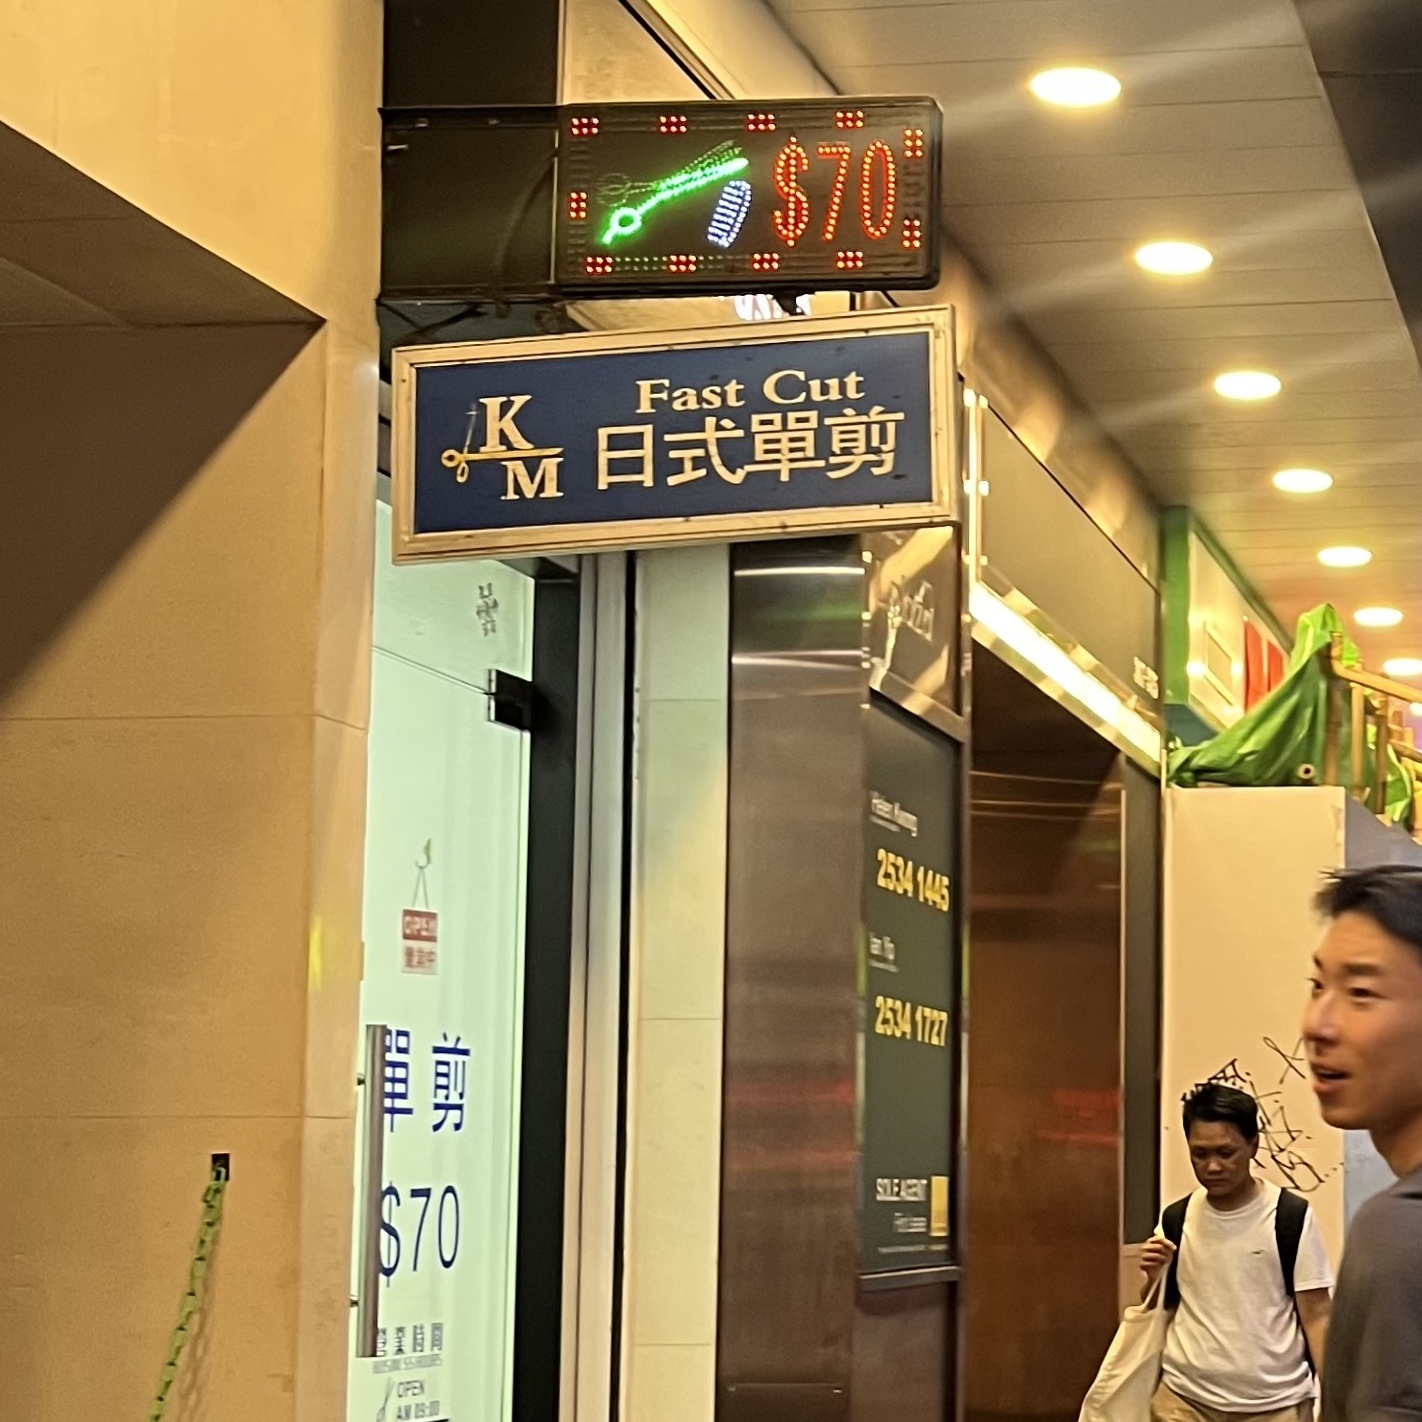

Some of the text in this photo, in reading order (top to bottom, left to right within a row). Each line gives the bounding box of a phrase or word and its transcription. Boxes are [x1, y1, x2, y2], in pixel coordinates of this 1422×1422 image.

[773, 136, 897, 248] $70
[635, 369, 866, 414] Fast Cut
[597, 405, 905, 490] 日式單剪
[877, 848, 950, 912] 2534 1445
[875, 995, 948, 1047] 2534 1727
[379, 1180, 460, 1288] $70
[397, 1380, 425, 1398] OPEN
